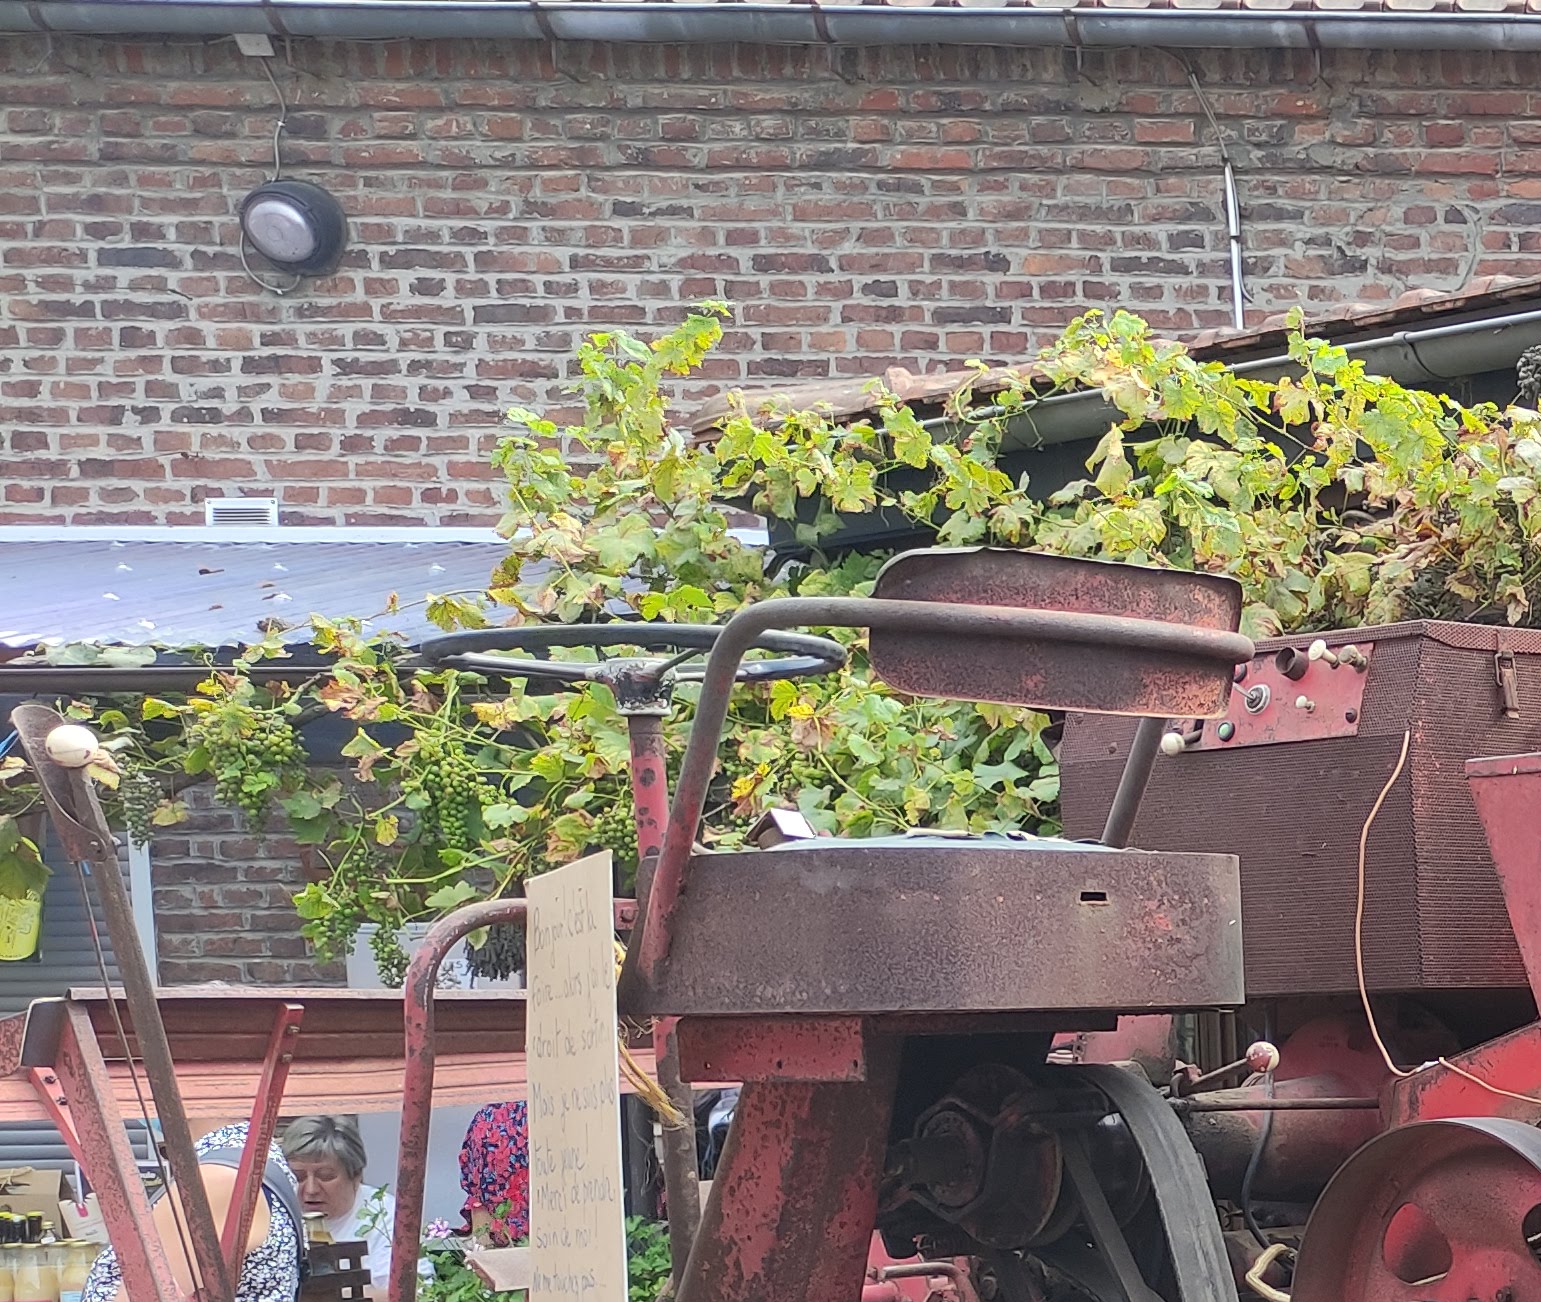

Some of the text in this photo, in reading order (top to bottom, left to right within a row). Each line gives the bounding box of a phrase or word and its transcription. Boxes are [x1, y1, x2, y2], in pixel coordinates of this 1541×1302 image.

[564, 1017, 577, 1056] de
[532, 1082, 555, 1123] Mais
[541, 1181, 567, 1212] Merci
[571, 1171, 581, 1204] de
[560, 1215, 571, 1248] de
